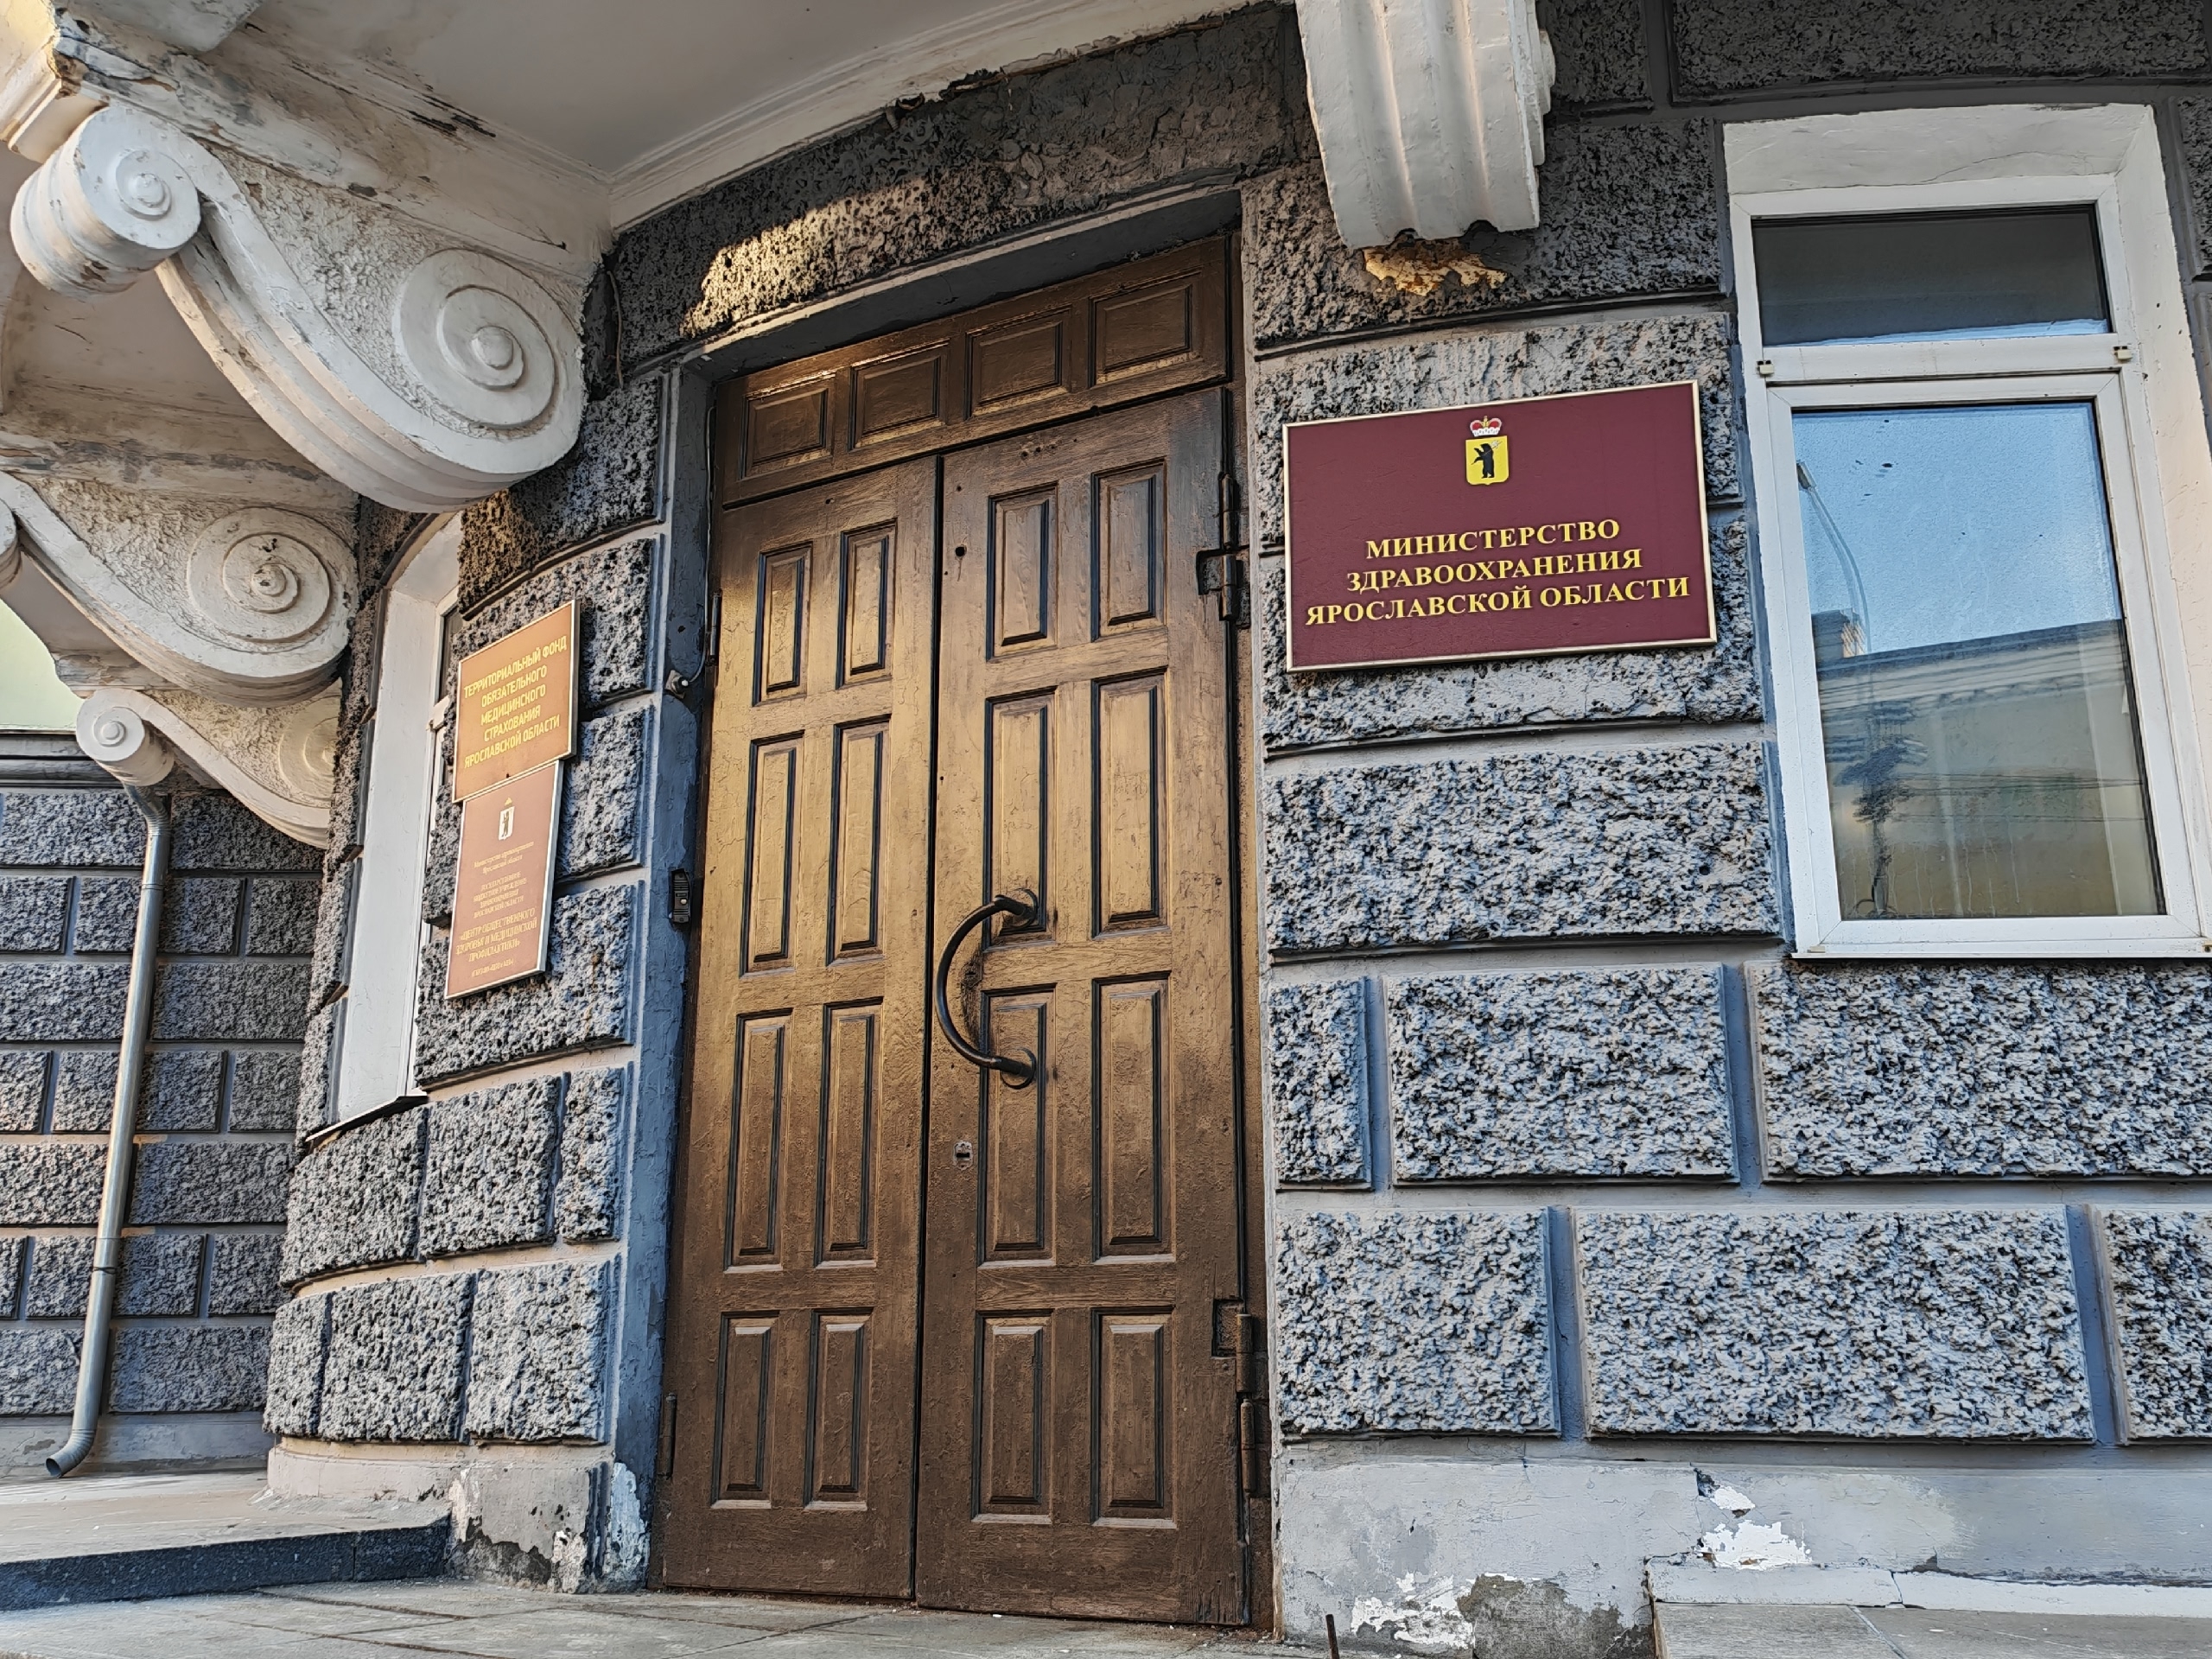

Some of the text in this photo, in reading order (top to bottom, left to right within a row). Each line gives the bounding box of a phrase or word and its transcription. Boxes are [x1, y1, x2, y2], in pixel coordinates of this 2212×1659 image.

[1365, 518, 1620, 559] МИНИСТЕРСТВО
[1346, 548, 1643, 594] ЗДРАВООХРАНЕНИЯ
[1305, 576, 1690, 626] ЯРОСЛАВСКОЙ ОБЛАСТИ
[463, 635, 567, 699] ТЕРРИТОРИАЛЬНЫЙ ФОНД
[480, 664, 548, 708] ОБЯЗАТЕЛЬНОГО
[480, 683, 546, 726] МЕДИЦИНСКОГО
[484, 704, 541, 742] СТРАХОВАНИЯ
[463, 714, 560, 769] ЯРОСЛАВСКОЙ ОБЛАСТИ
